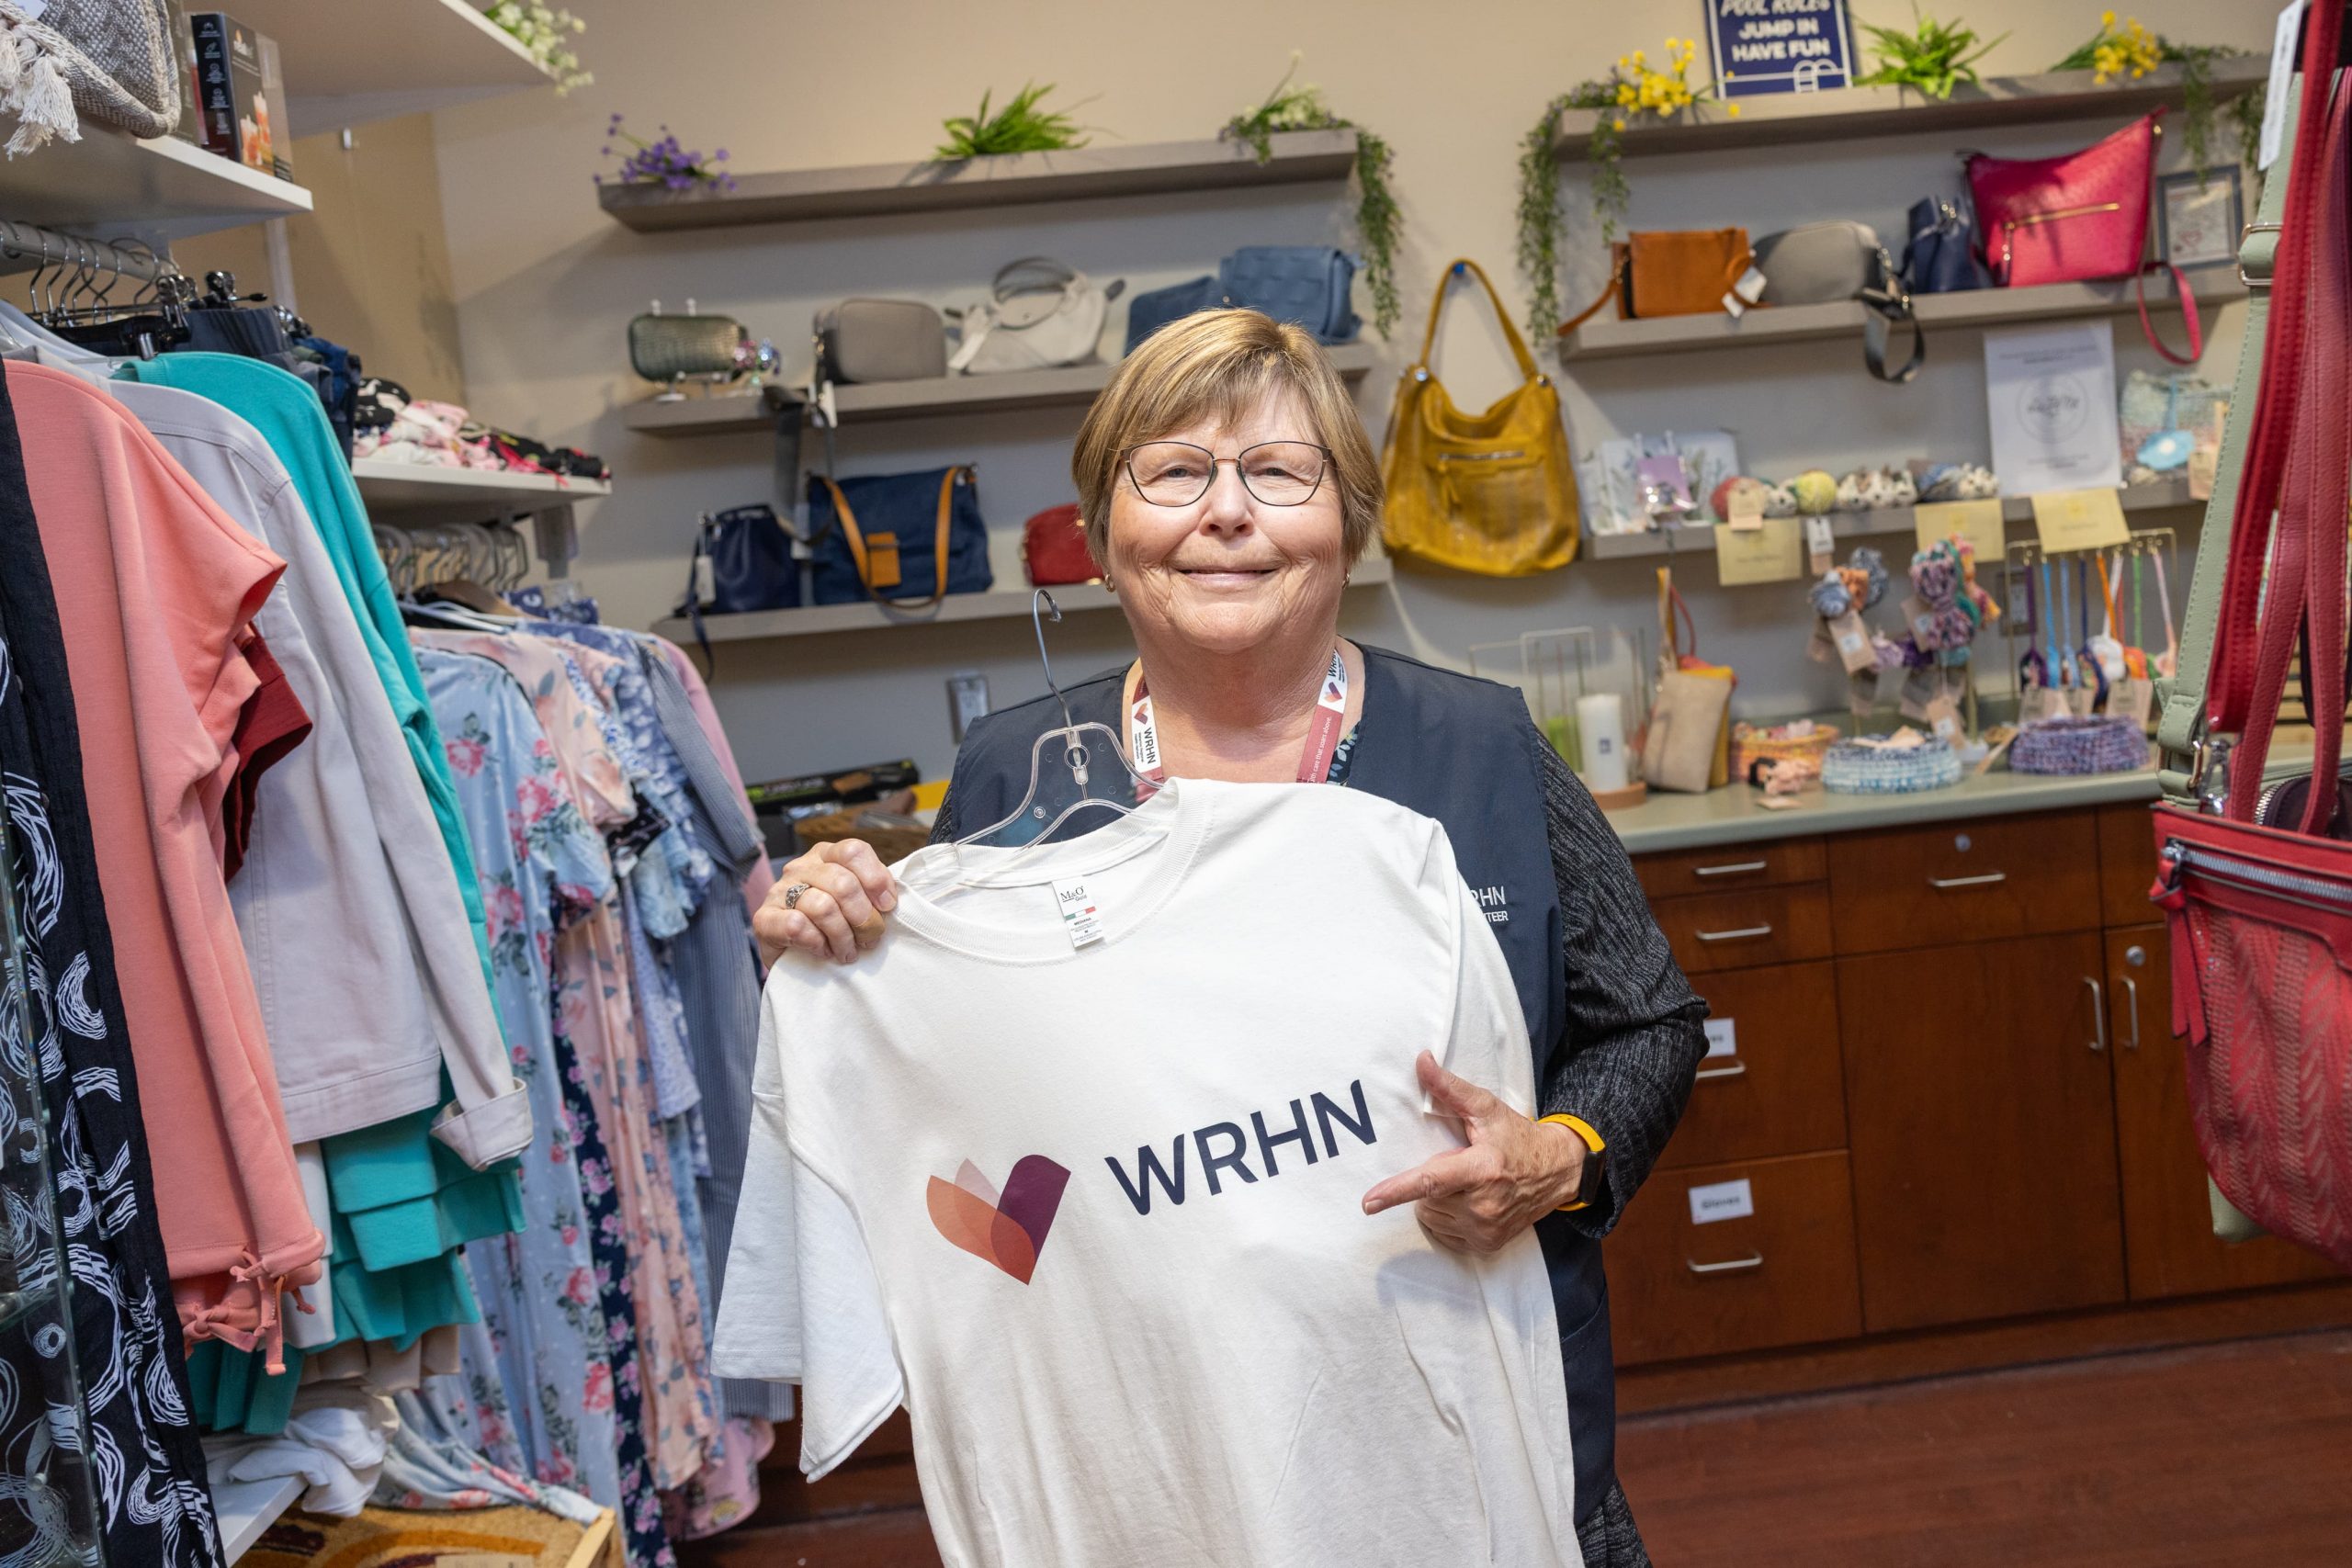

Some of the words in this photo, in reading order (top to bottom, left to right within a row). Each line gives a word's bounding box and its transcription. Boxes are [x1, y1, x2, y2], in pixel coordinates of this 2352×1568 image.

[1738, 19, 1795, 39] JUMP
[1796, 17, 1819, 36] IN
[1731, 41, 1787, 62] HAVE
[1788, 38, 1831, 58] FUN
[1144, 727, 1157, 764] WRHN
[1470, 886, 1506, 907] HN
[1484, 910, 1509, 922] TEER
[1103, 1079, 1378, 1216] WRHN
